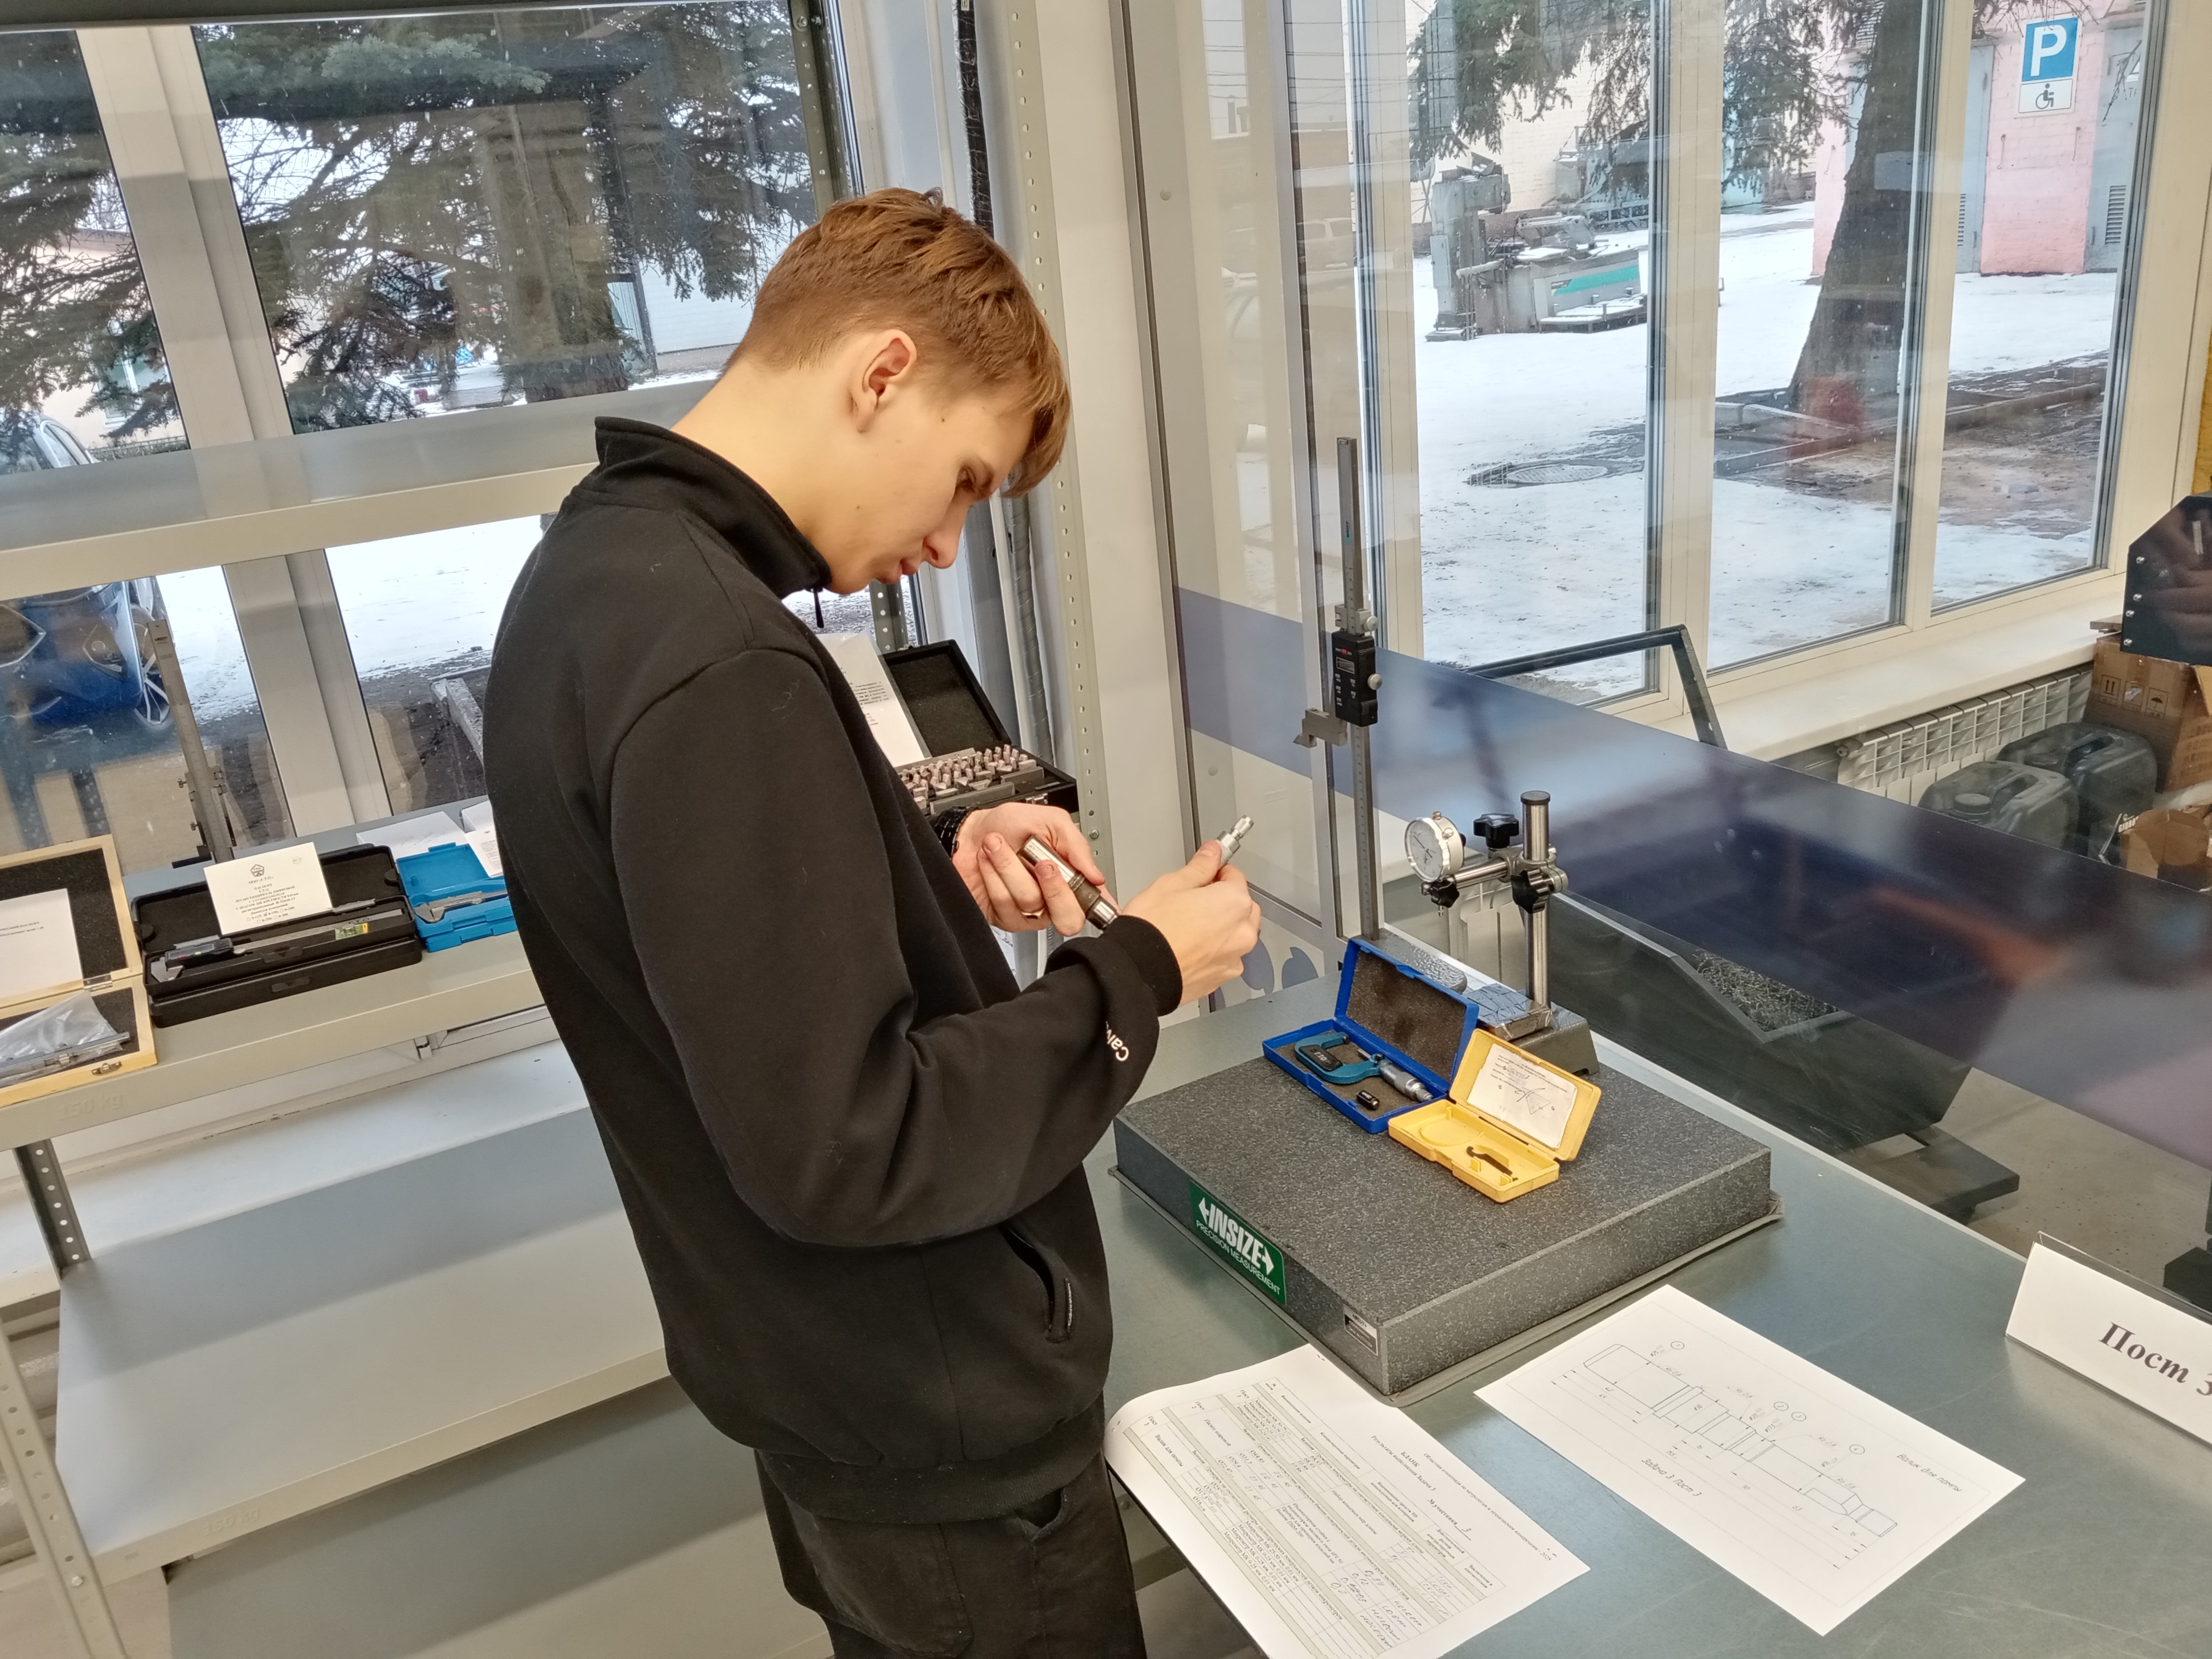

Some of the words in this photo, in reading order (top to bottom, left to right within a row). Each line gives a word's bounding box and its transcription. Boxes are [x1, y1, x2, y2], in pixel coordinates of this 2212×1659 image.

[2030, 25, 2067, 77] P
[1196, 1220, 1230, 1253] PRECISION
[1230, 1247, 1281, 1295] MEASUREMENT
[1208, 1203, 1264, 1269] INSIZE
[2098, 1321, 2190, 1384] Пост
